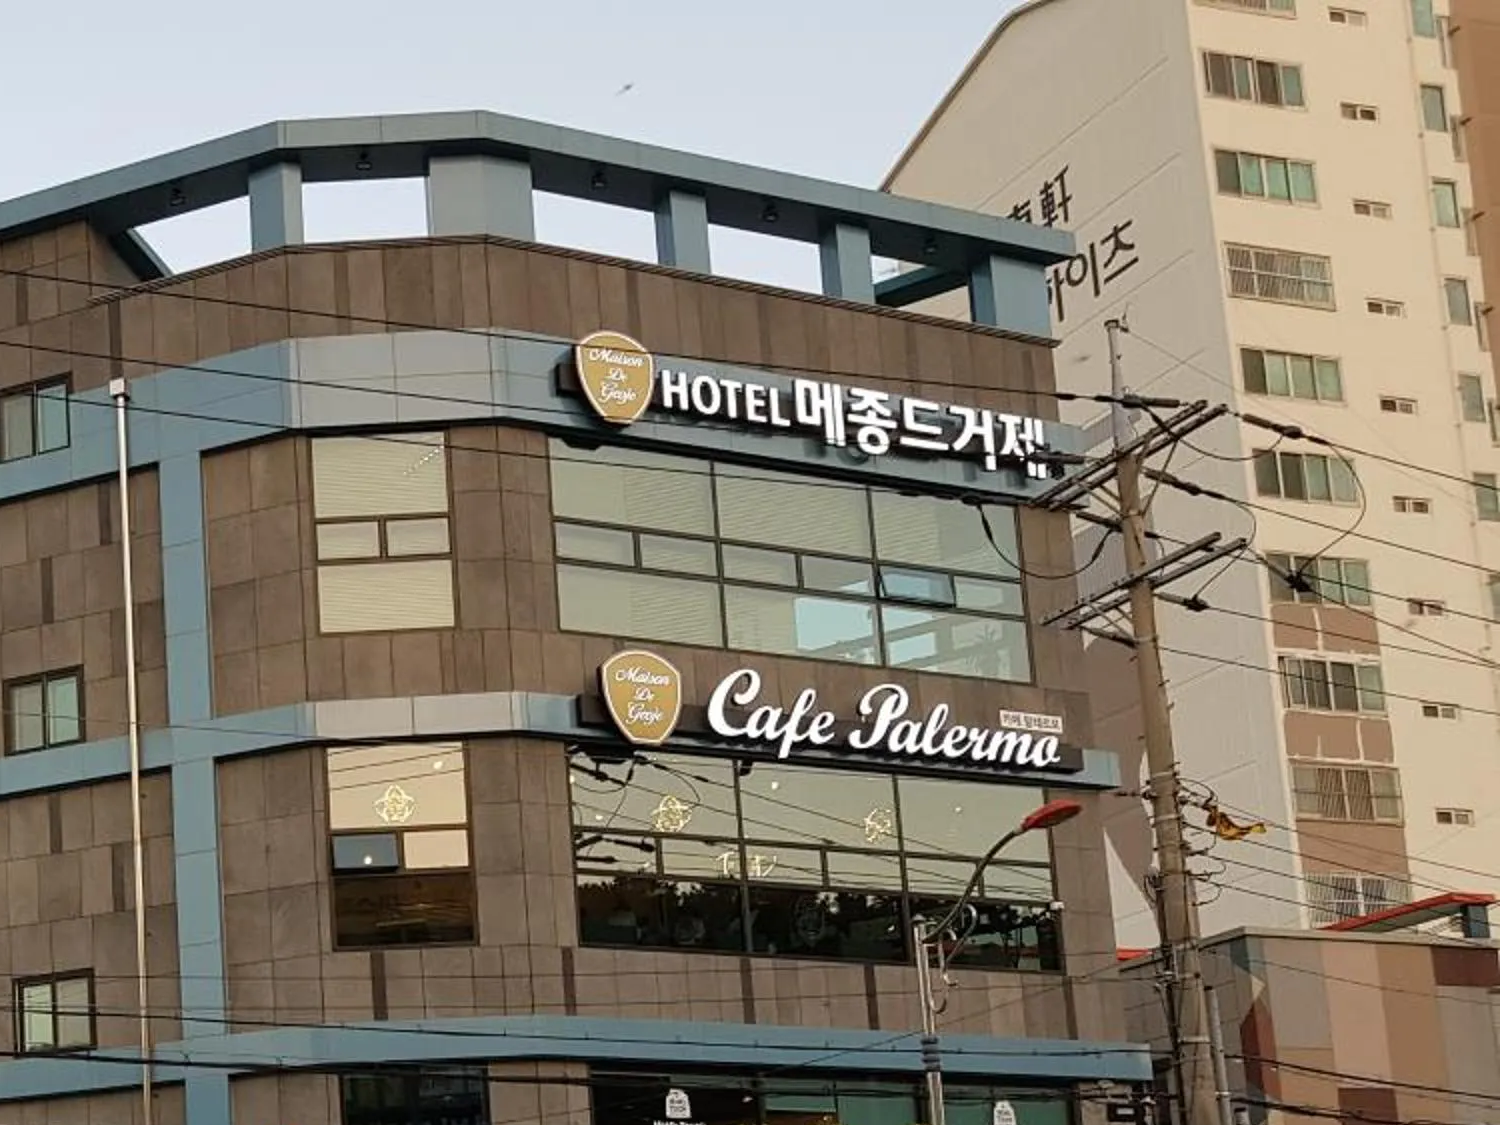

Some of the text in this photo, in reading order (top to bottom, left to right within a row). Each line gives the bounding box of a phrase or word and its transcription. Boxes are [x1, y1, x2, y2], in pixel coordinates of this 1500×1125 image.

[589, 348, 644, 367] Maison
[661, 369, 1047, 479] HOTEL 메종드거제
[615, 667, 669, 685] Maison
[707, 669, 1061, 767] Cafe Palermo
